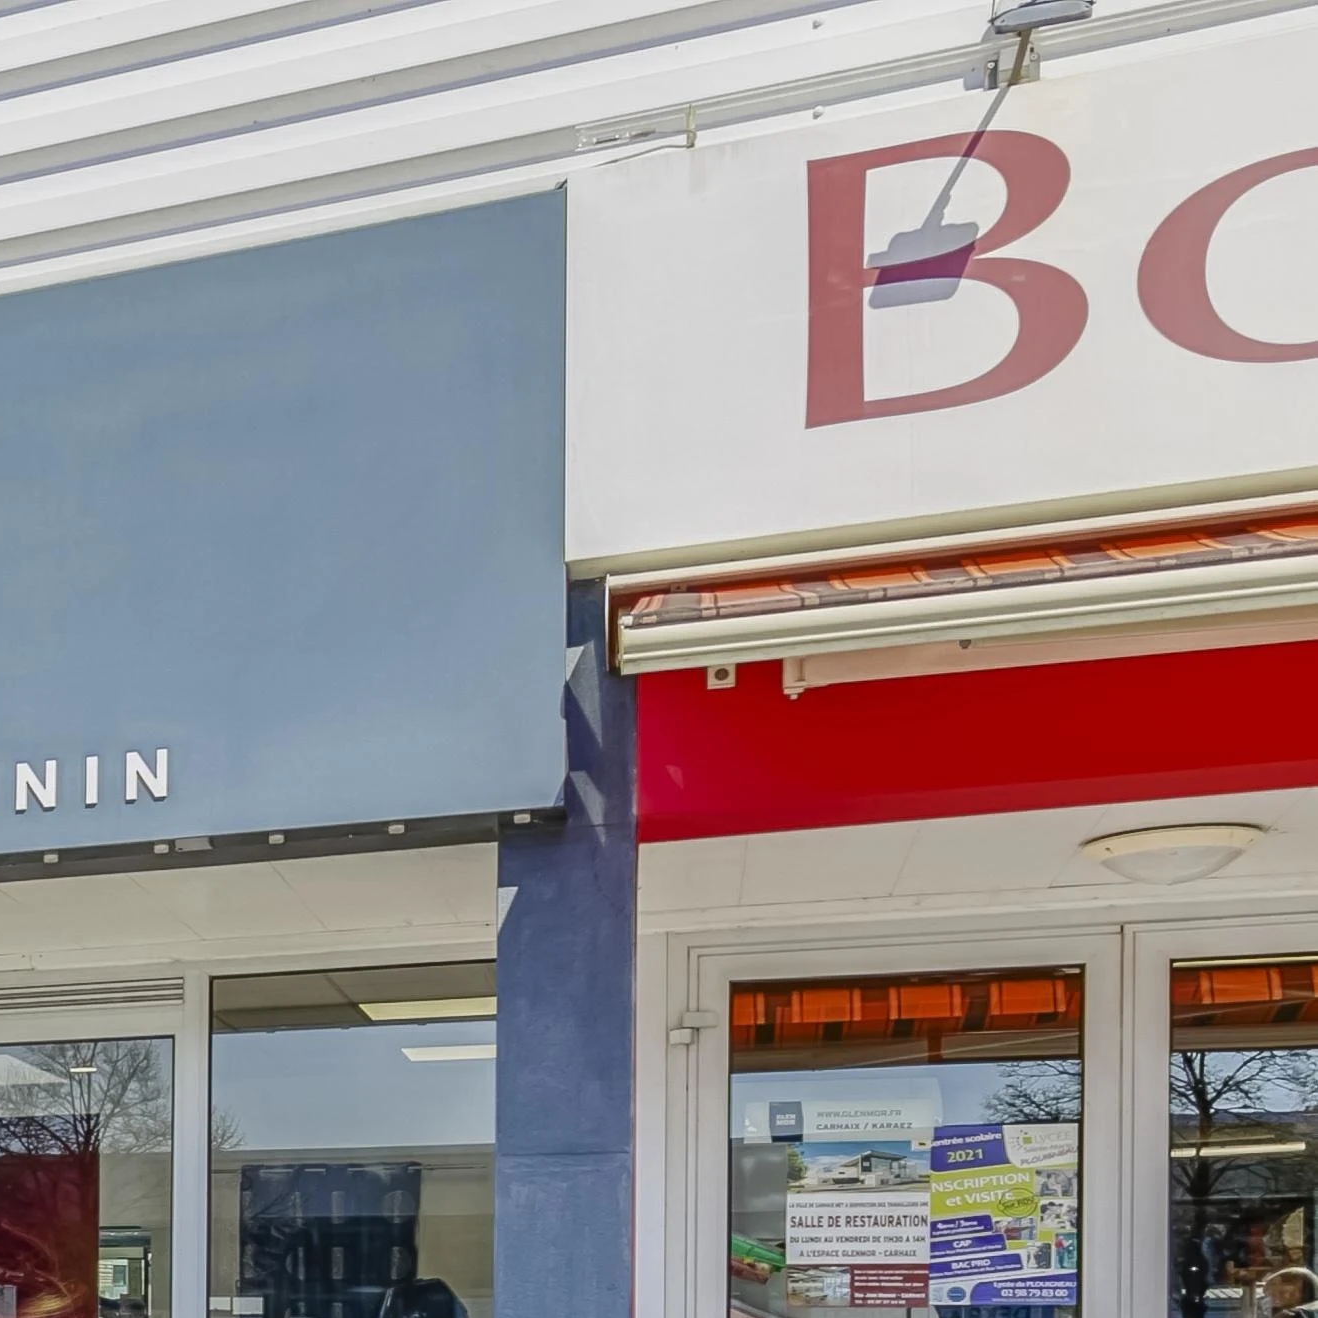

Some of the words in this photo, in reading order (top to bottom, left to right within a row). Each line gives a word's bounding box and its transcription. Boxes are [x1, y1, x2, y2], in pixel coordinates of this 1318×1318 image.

[931, 1136, 964, 1147] entrée
[965, 1132, 1002, 1142] scolaire
[946, 1148, 983, 1163] 2021
[931, 1172, 1031, 1193] NSCRIPTION
[946, 1195, 962, 1207] et
[790, 1216, 824, 1228] SALLE
[827, 1216, 841, 1228] DE
[845, 1215, 928, 1228] RESTAURATION
[790, 1236, 800, 1244] DU
[801, 1236, 822, 1244] LUNDI
